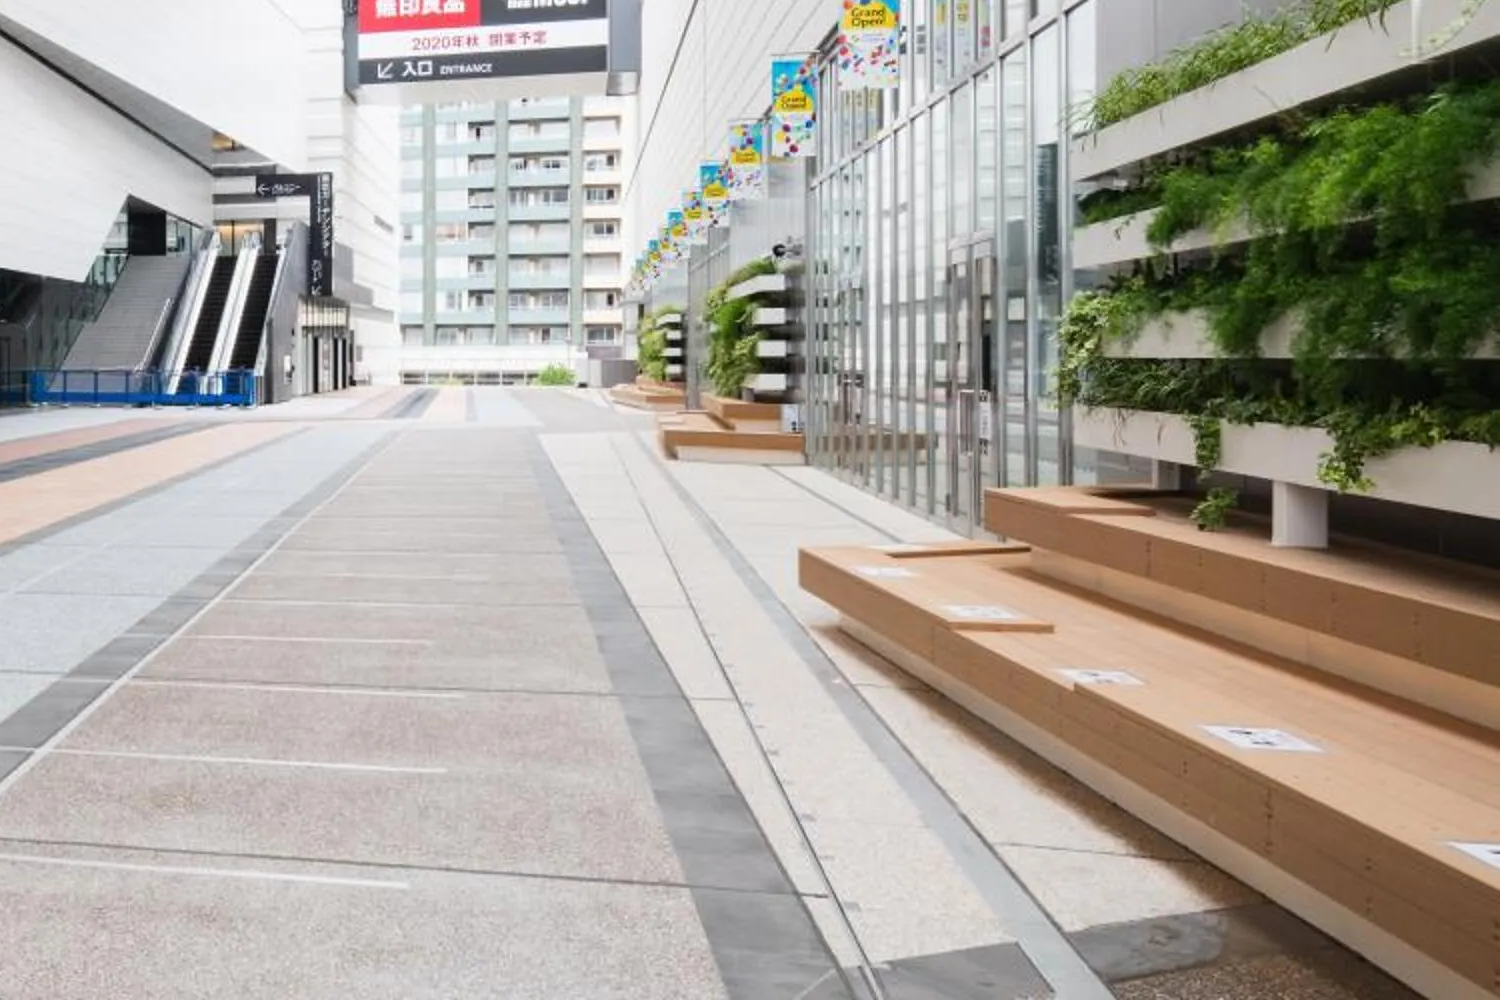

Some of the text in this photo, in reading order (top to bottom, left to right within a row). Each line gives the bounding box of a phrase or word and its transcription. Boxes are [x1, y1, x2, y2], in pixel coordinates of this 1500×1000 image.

[851, 6, 886, 17] Grand
[411, 30, 548, 51] 2020年秋 開業予定
[401, 60, 494, 78] 入口 ENTRANCE
